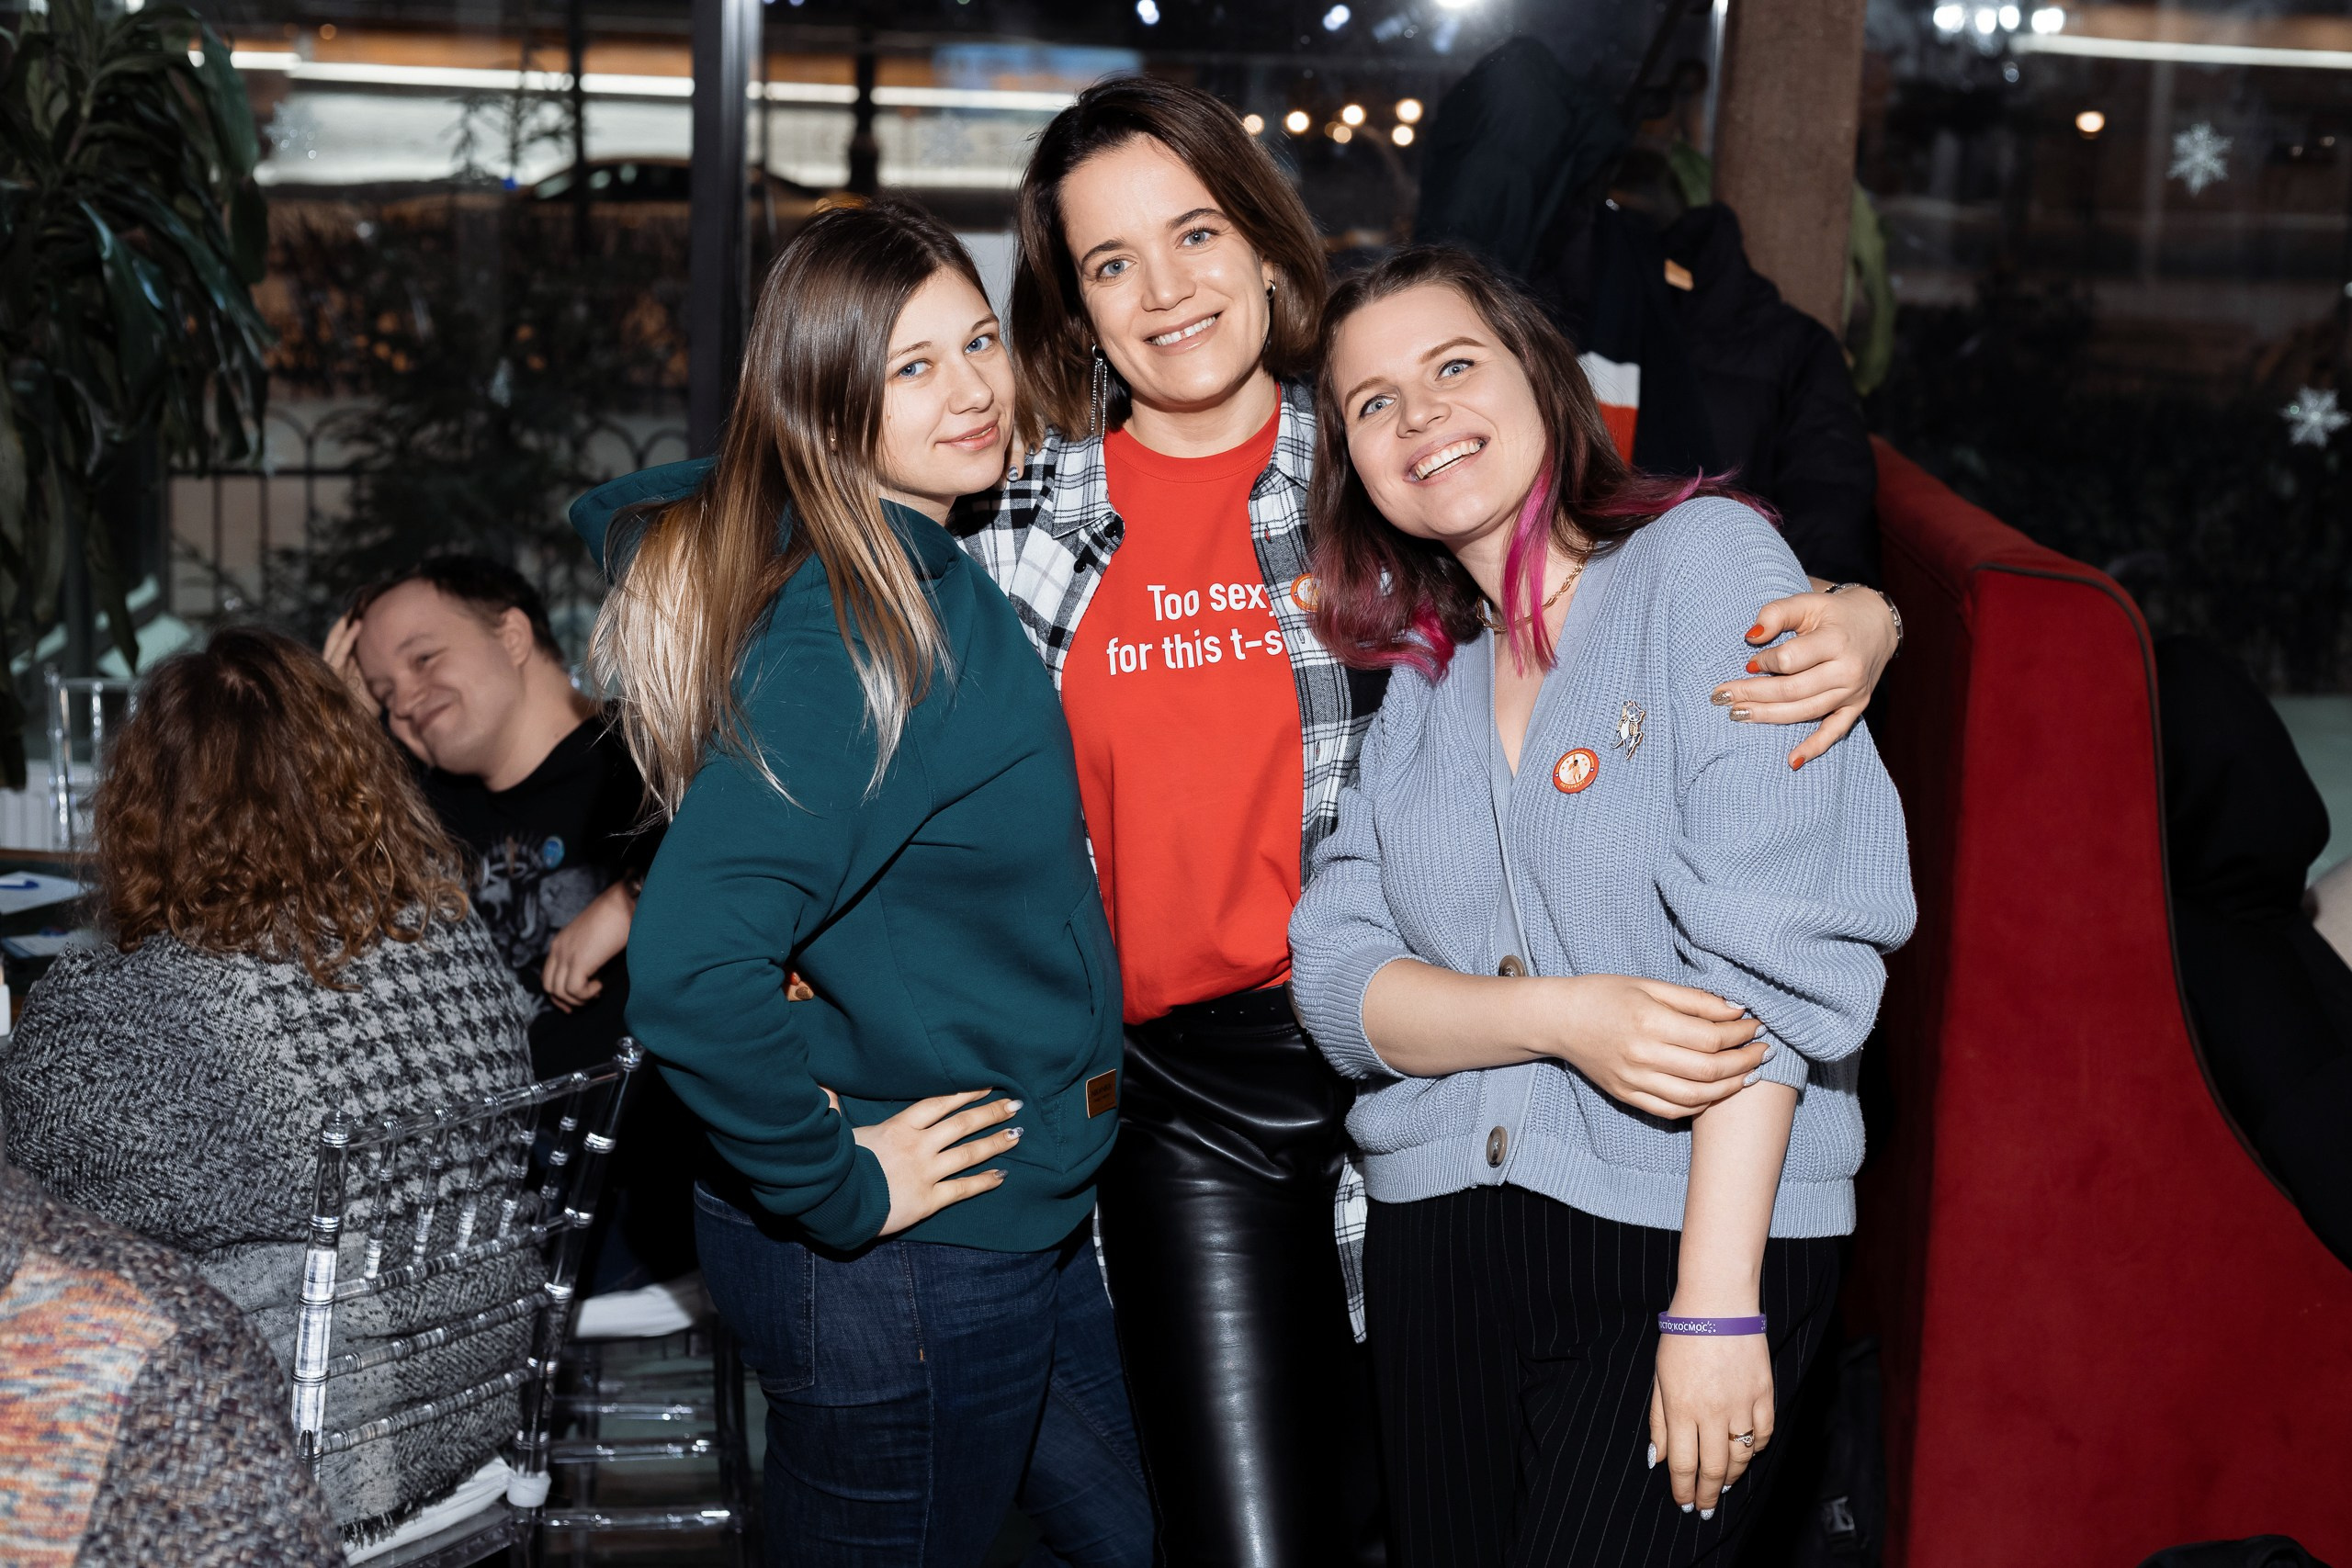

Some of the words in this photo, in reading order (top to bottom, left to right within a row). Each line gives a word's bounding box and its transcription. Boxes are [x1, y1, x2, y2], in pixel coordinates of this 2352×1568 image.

[1147, 584, 1200, 621] Too
[1209, 582, 1275, 617] sex
[1106, 637, 1153, 675] for
[1161, 628, 1223, 669] this
